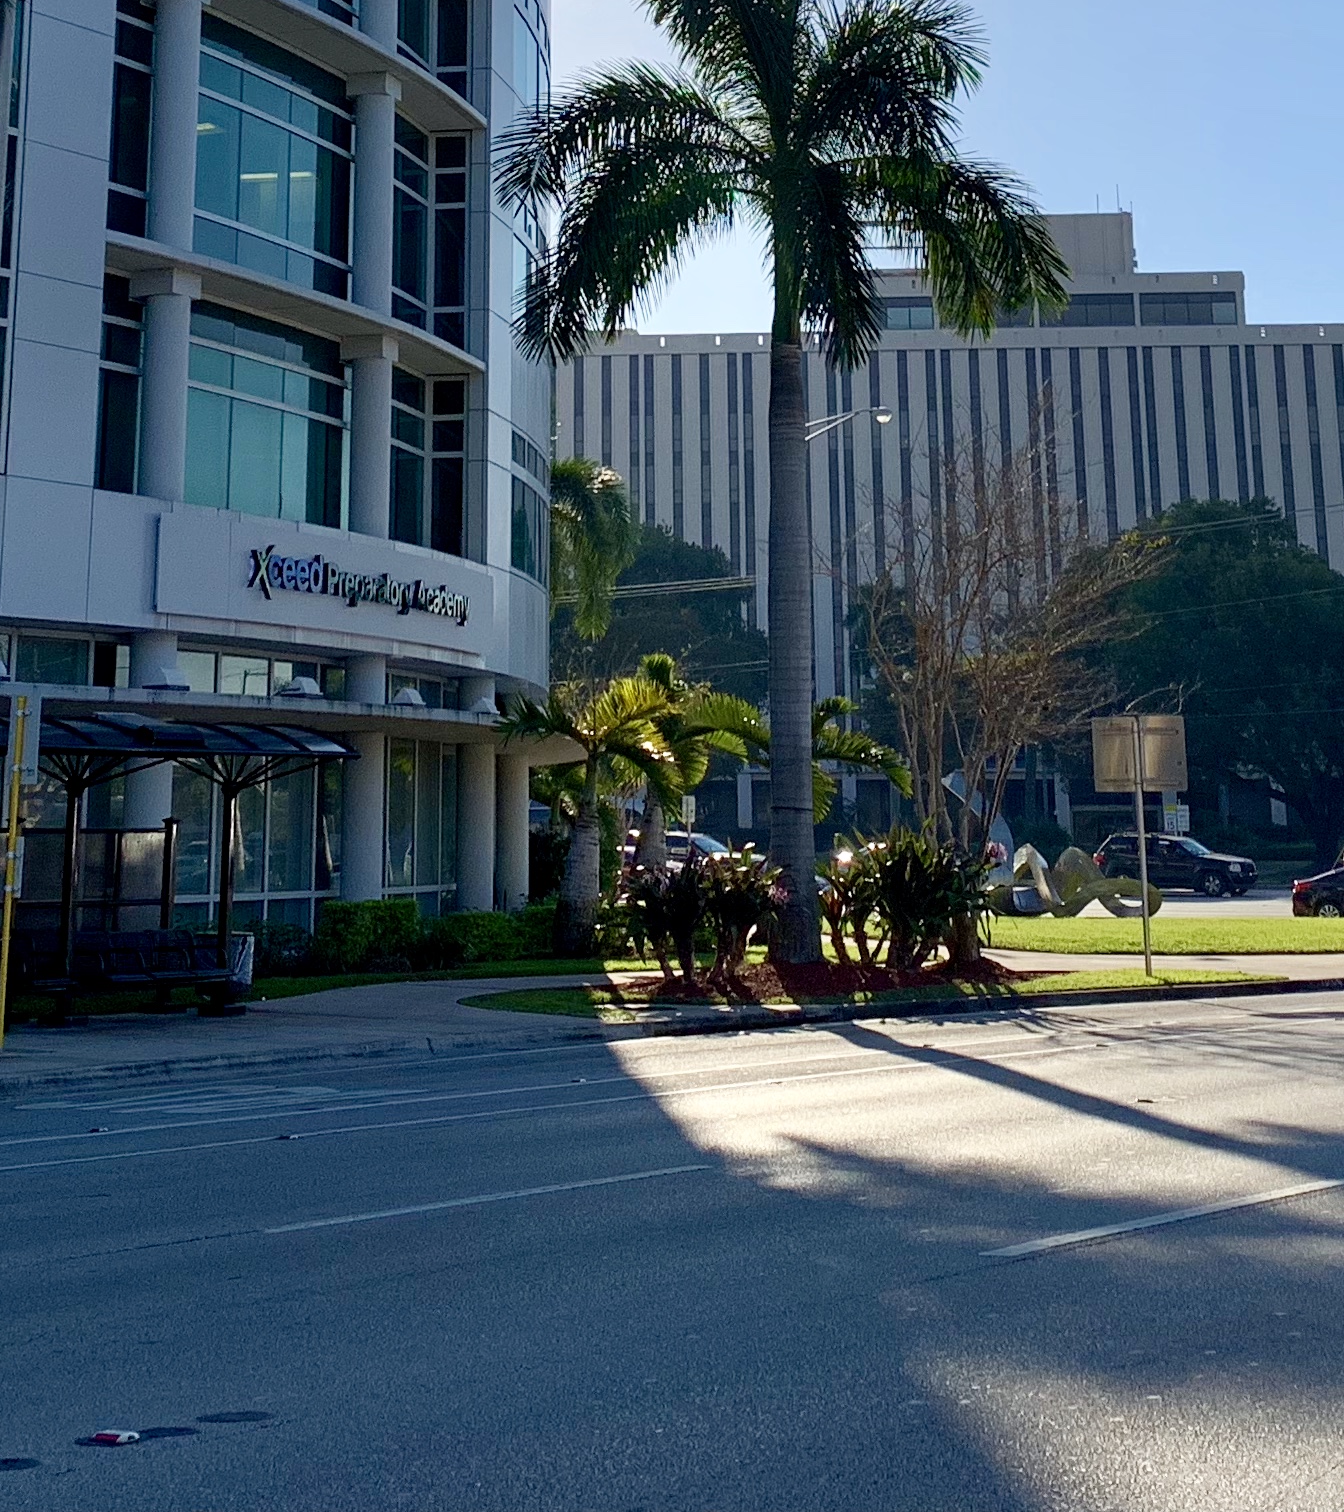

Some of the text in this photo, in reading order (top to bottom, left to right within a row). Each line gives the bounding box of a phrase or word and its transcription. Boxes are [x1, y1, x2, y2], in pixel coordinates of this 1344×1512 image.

[248, 545, 470, 626] Xceed Preparatory Academy
